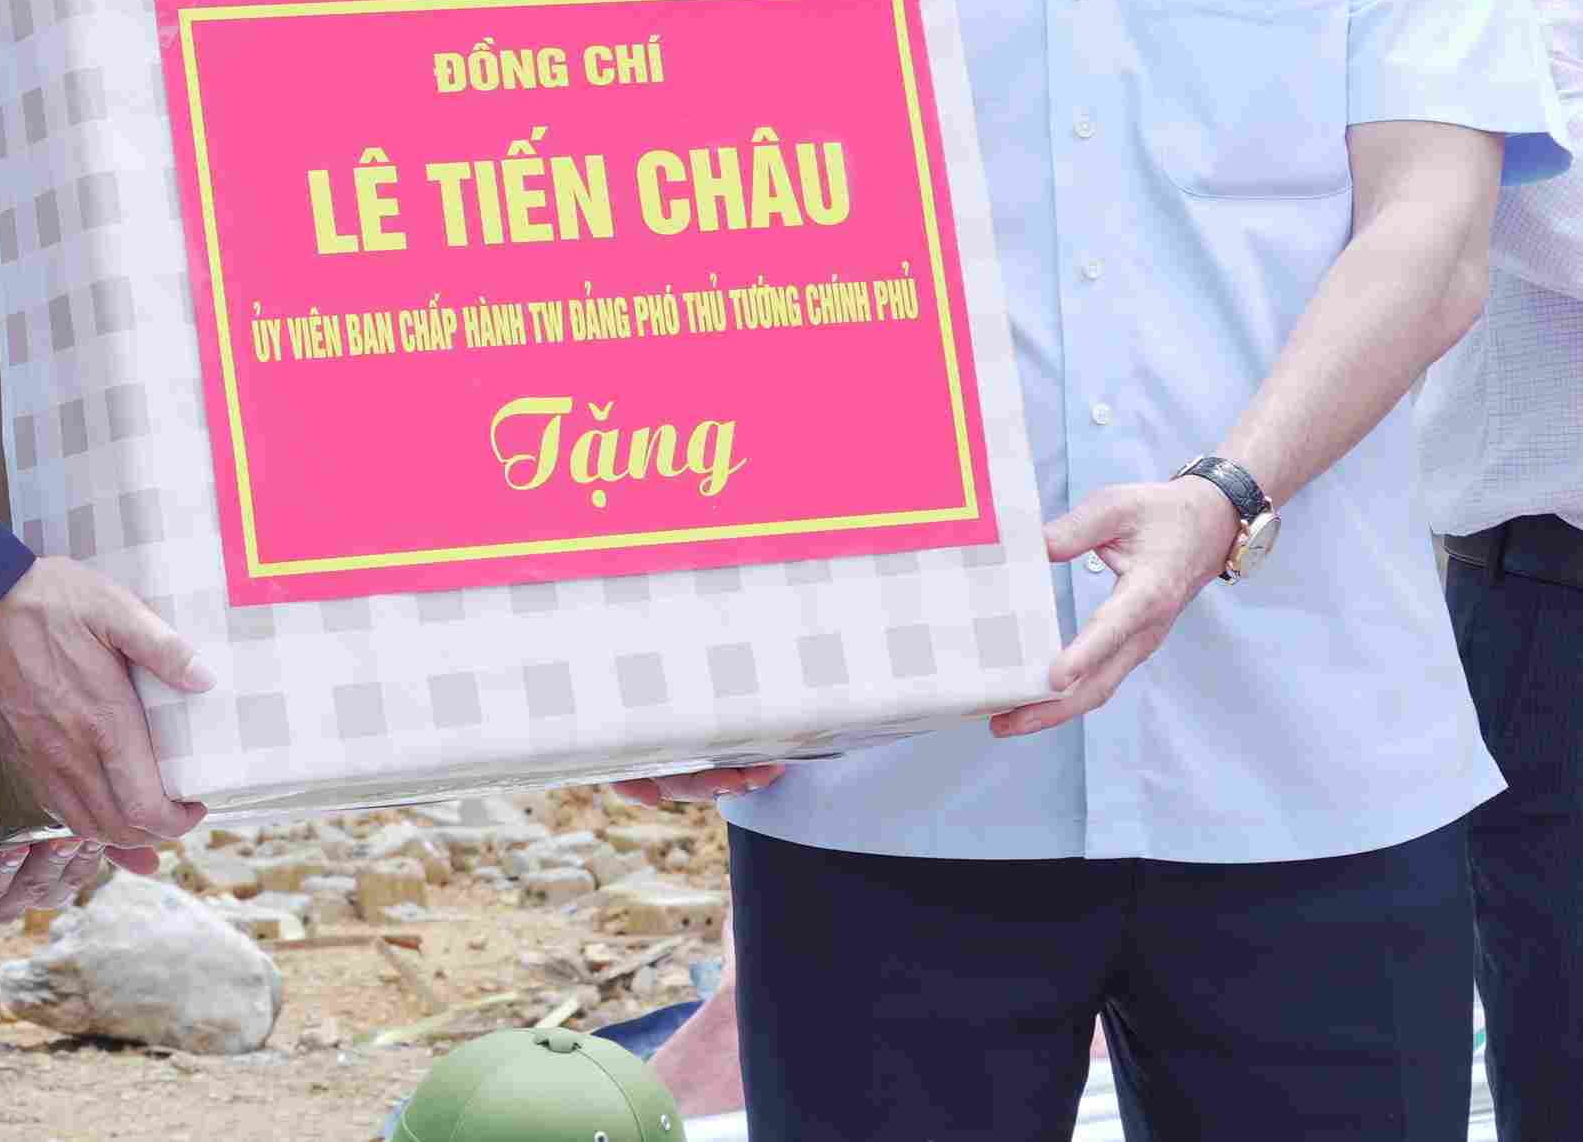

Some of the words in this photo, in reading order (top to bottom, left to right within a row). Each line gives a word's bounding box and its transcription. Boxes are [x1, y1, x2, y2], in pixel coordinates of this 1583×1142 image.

[433, 36, 568, 93] ĐỒNG
[583, 33, 664, 86] CHÍ
[307, 147, 407, 255] LÊ
[425, 126, 614, 246] TIẾN
[636, 126, 851, 235] CHÂU
[251, 301, 282, 363] ỦY
[286, 306, 343, 360] VIÊN
[345, 311, 396, 356] BAN
[398, 293, 458, 354] CHẤP
[461, 295, 527, 348] HÀNH
[528, 301, 564, 344] TW
[568, 280, 631, 342] ĐẢNG
[633, 283, 680, 338] PHÓ
[681, 273, 727, 334] THỦ
[728, 275, 802, 331] TƯỚNG
[804, 274, 872, 326] CHÍNH
[873, 260, 919, 322] PHỦ
[490, 395, 747, 508] Tặng
